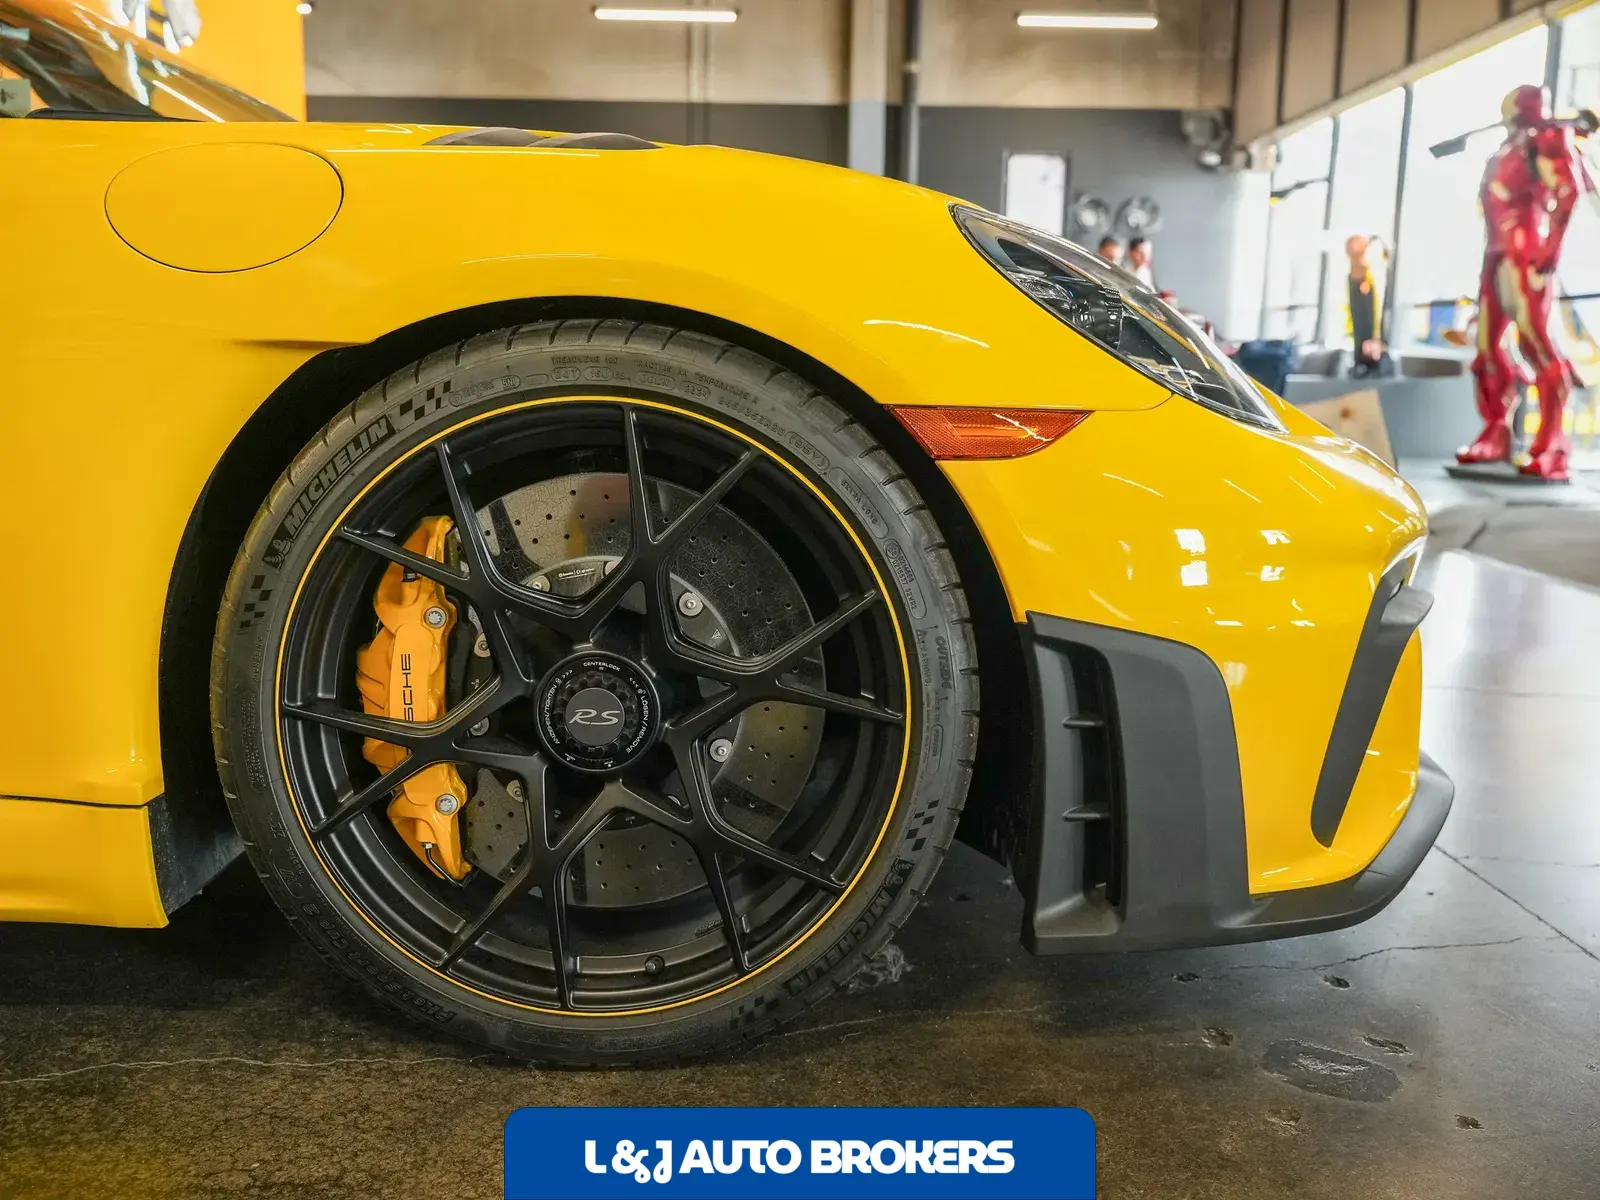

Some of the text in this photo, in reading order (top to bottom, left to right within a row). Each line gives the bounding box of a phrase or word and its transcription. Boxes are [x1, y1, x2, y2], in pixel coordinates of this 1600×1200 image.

[283, 418, 392, 537] MICHELIN
[840, 478, 862, 503] EXTRA
[583, 661, 621, 672] CENTERLOCK
[934, 635, 951, 690] OUTSIDE
[569, 708, 621, 726] RS
[317, 917, 349, 950] Cup
[789, 889, 894, 996] MICHELIN
[347, 949, 403, 993] Sport
[402, 989, 458, 1023] Pilot
